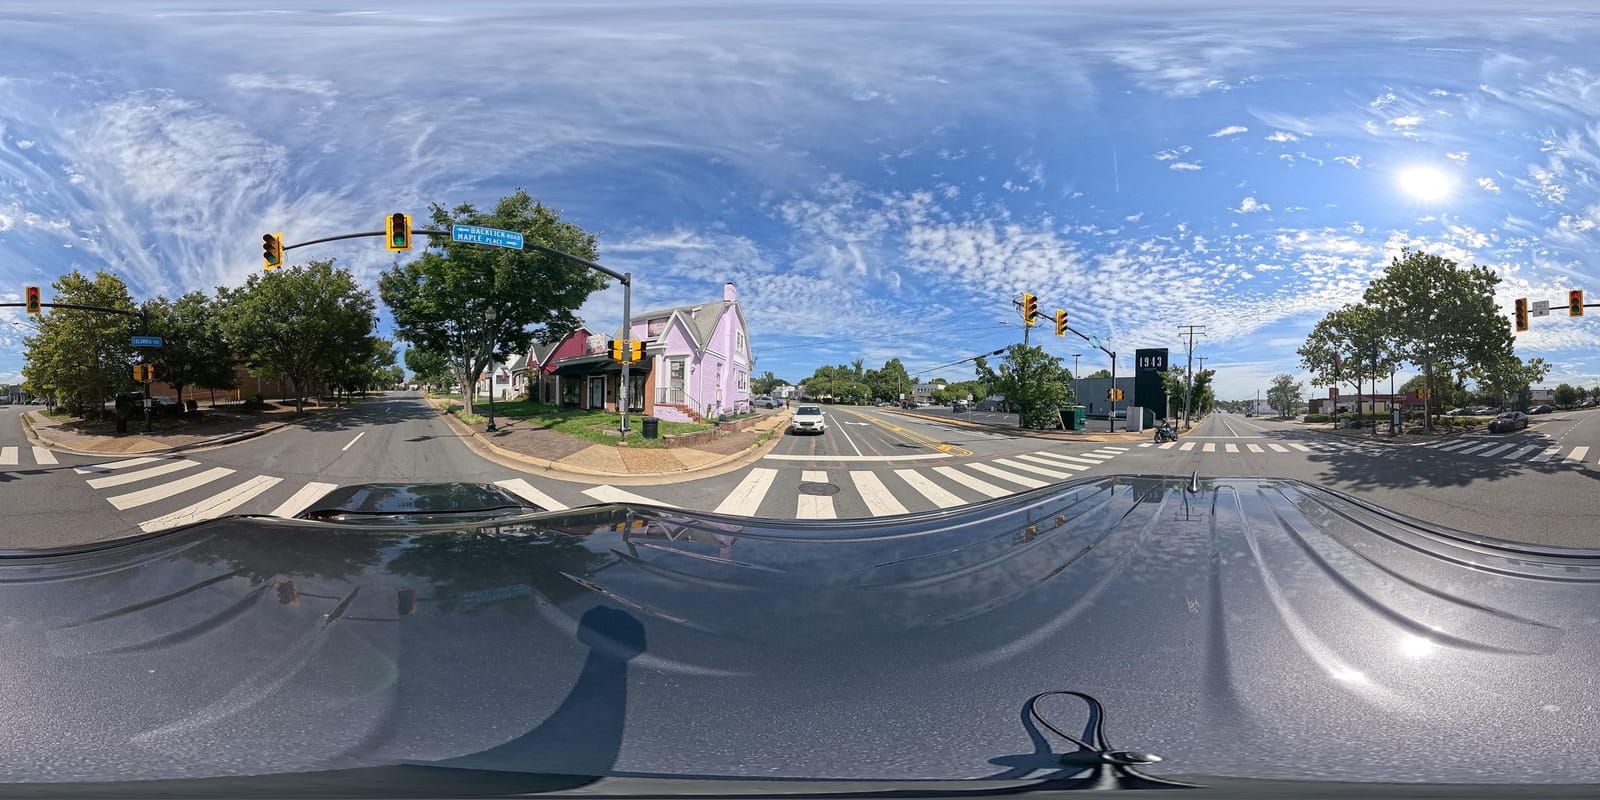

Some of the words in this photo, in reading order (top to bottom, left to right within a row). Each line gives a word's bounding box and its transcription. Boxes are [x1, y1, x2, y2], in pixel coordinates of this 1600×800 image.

[458, 233, 483, 241] MAPLE
[471, 227, 505, 238] BACKLICK
[1140, 356, 1162, 368] 1943
